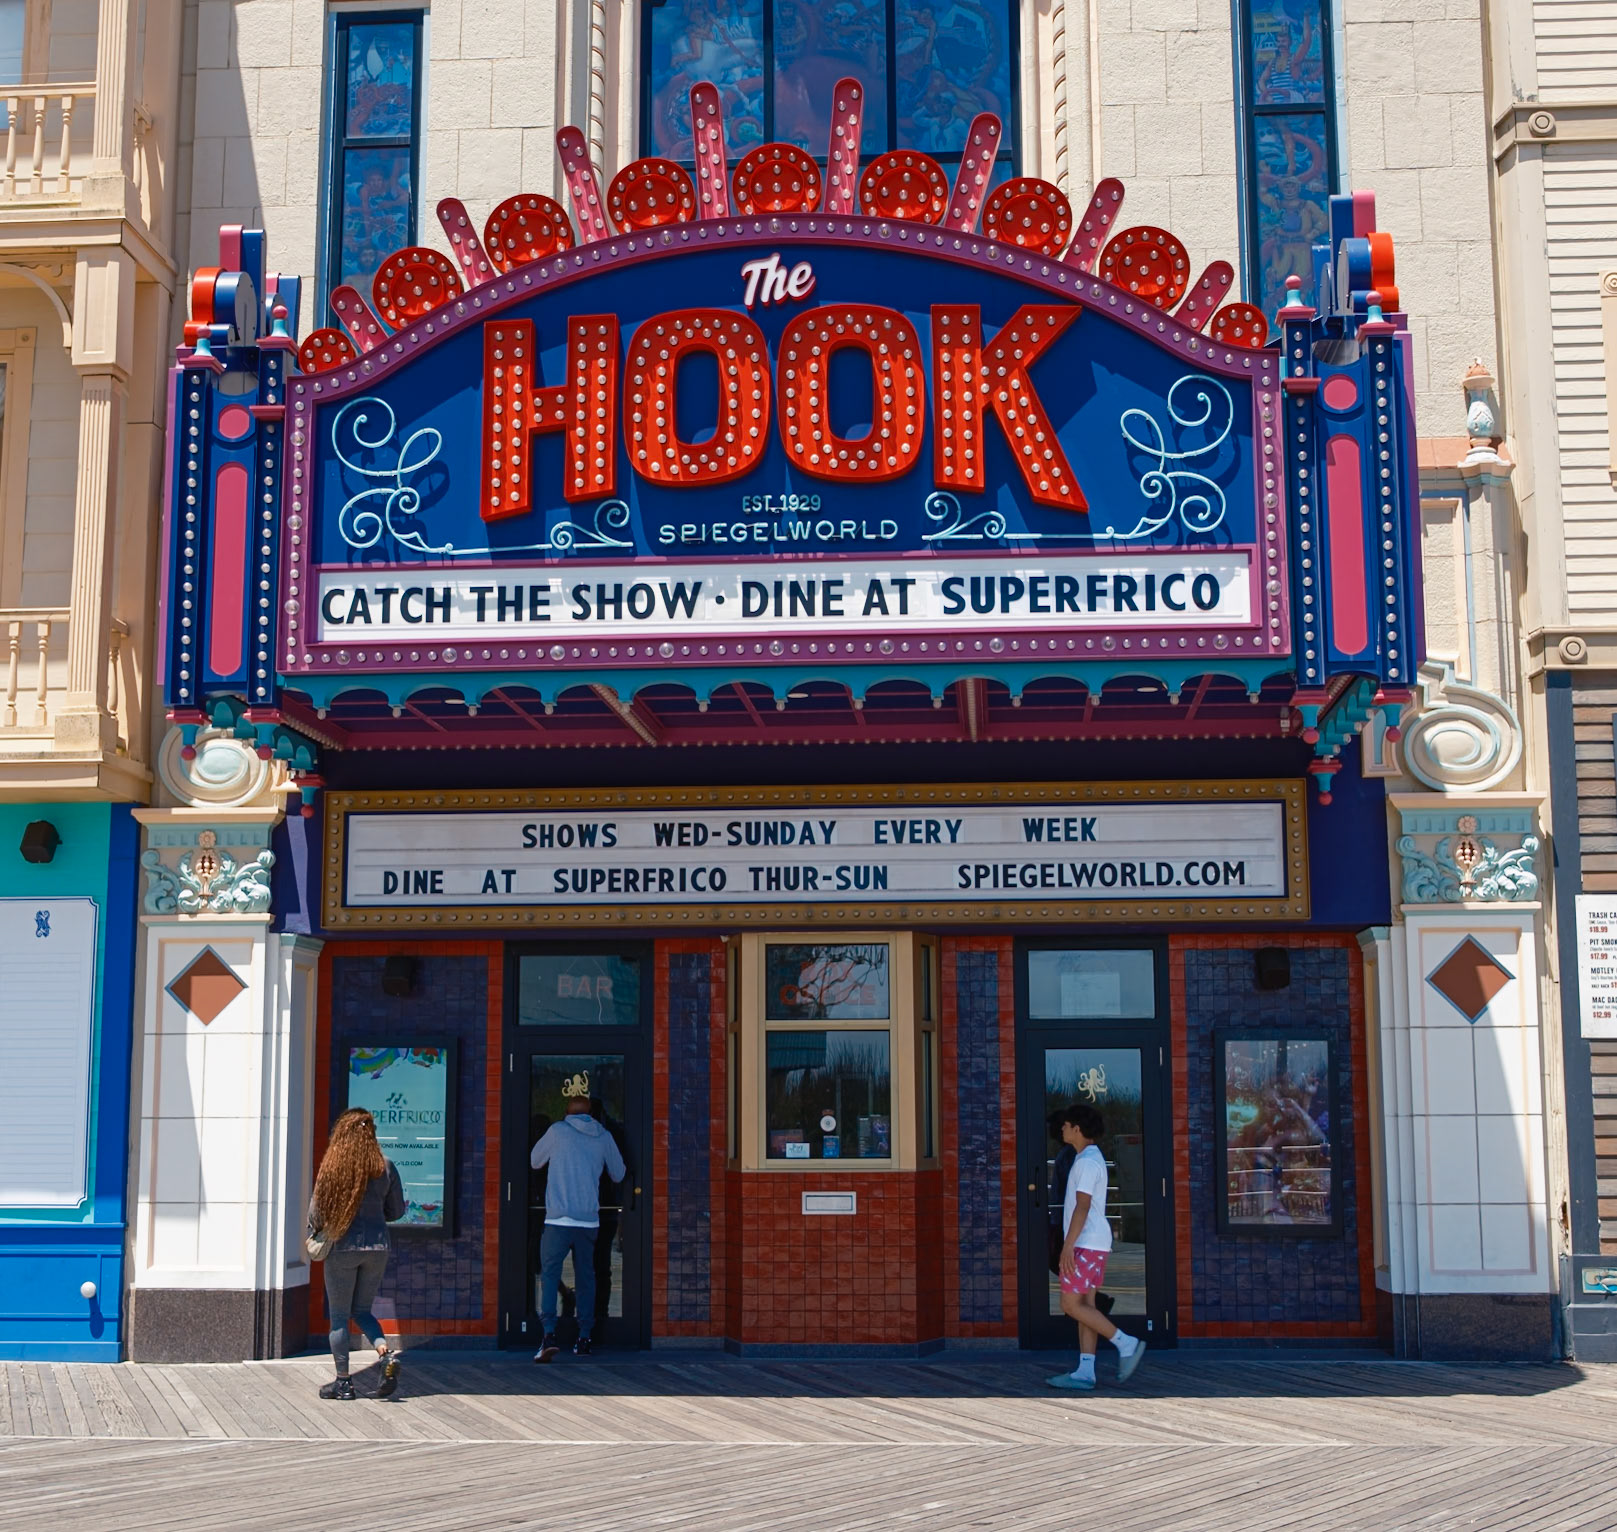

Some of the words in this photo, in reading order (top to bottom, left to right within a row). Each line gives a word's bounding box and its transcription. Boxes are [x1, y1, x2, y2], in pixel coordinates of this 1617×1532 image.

[741, 252, 816, 310] The
[480, 303, 1090, 522] HOOK
[780, 494, 821, 512] 1929
[658, 519, 899, 544] SPIEGELWORLD
[321, 587, 451, 625] CATCH
[470, 585, 551, 622] THE
[572, 581, 703, 620] SHOW
[742, 579, 844, 618] DINE
[862, 578, 916, 616] AT
[941, 573, 1220, 615] SUPERFRICO
[522, 823, 617, 848] SHOWS
[653, 820, 837, 847] WED-SUNDAY
[874, 819, 963, 844] EVERY
[1022, 817, 1097, 842] WEEK
[383, 870, 444, 895] DINE
[481, 869, 517, 894] AT
[553, 867, 727, 893] SUPERFRICO
[749, 864, 888, 891] THUR-SUN
[958, 861, 1246, 889] SPIEGELWORLD.COM
[1588, 911, 1608, 919] TRASH
[557, 974, 614, 1000] BAR
[371, 1110, 441, 1125] PERFRICO
